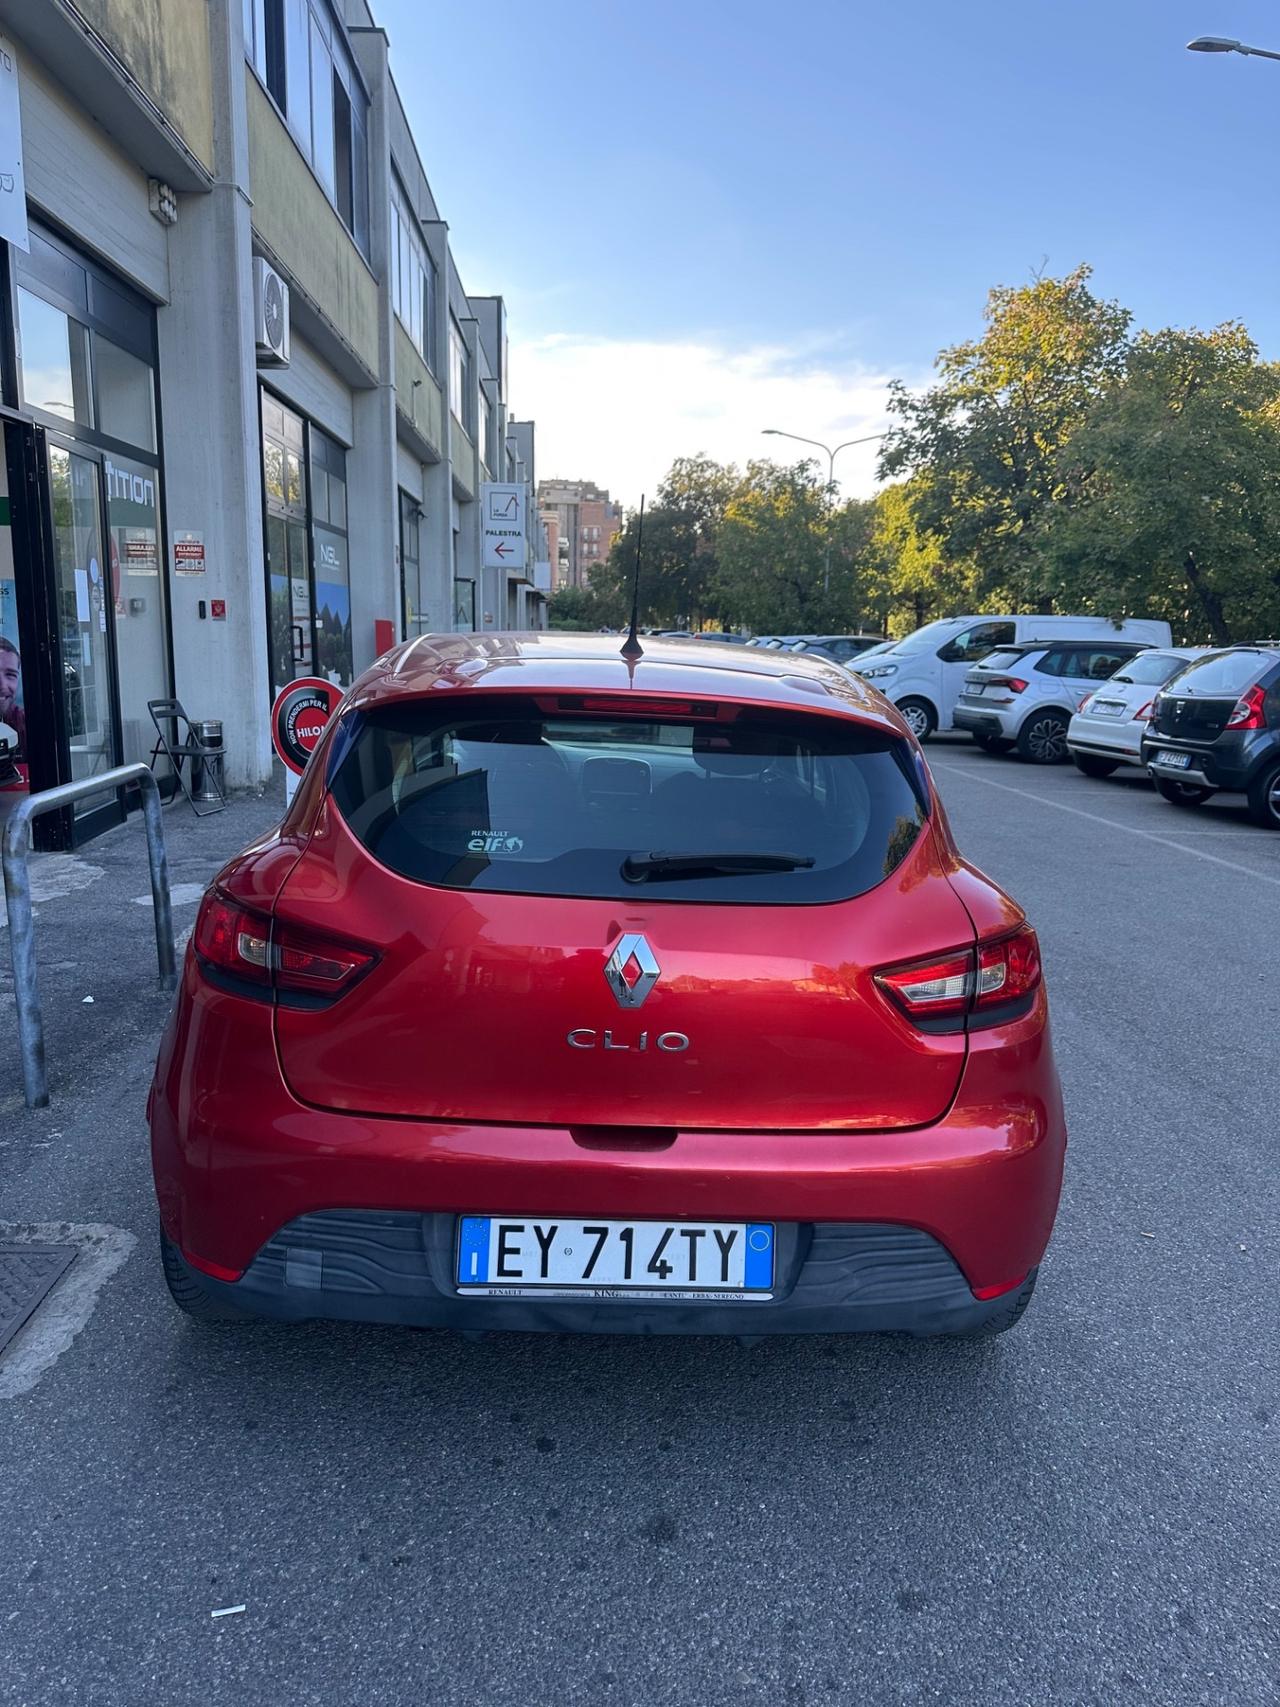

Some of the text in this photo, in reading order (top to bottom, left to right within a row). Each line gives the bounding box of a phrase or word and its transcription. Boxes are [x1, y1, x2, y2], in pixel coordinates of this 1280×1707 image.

[486, 529, 522, 537] PALESTRA
[310, 699, 321, 708] PER
[468, 837, 504, 852] elf
[567, 1028, 690, 1052] CLIO
[488, 1288, 523, 1296] RENAULT
[594, 1289, 619, 1298] KING
